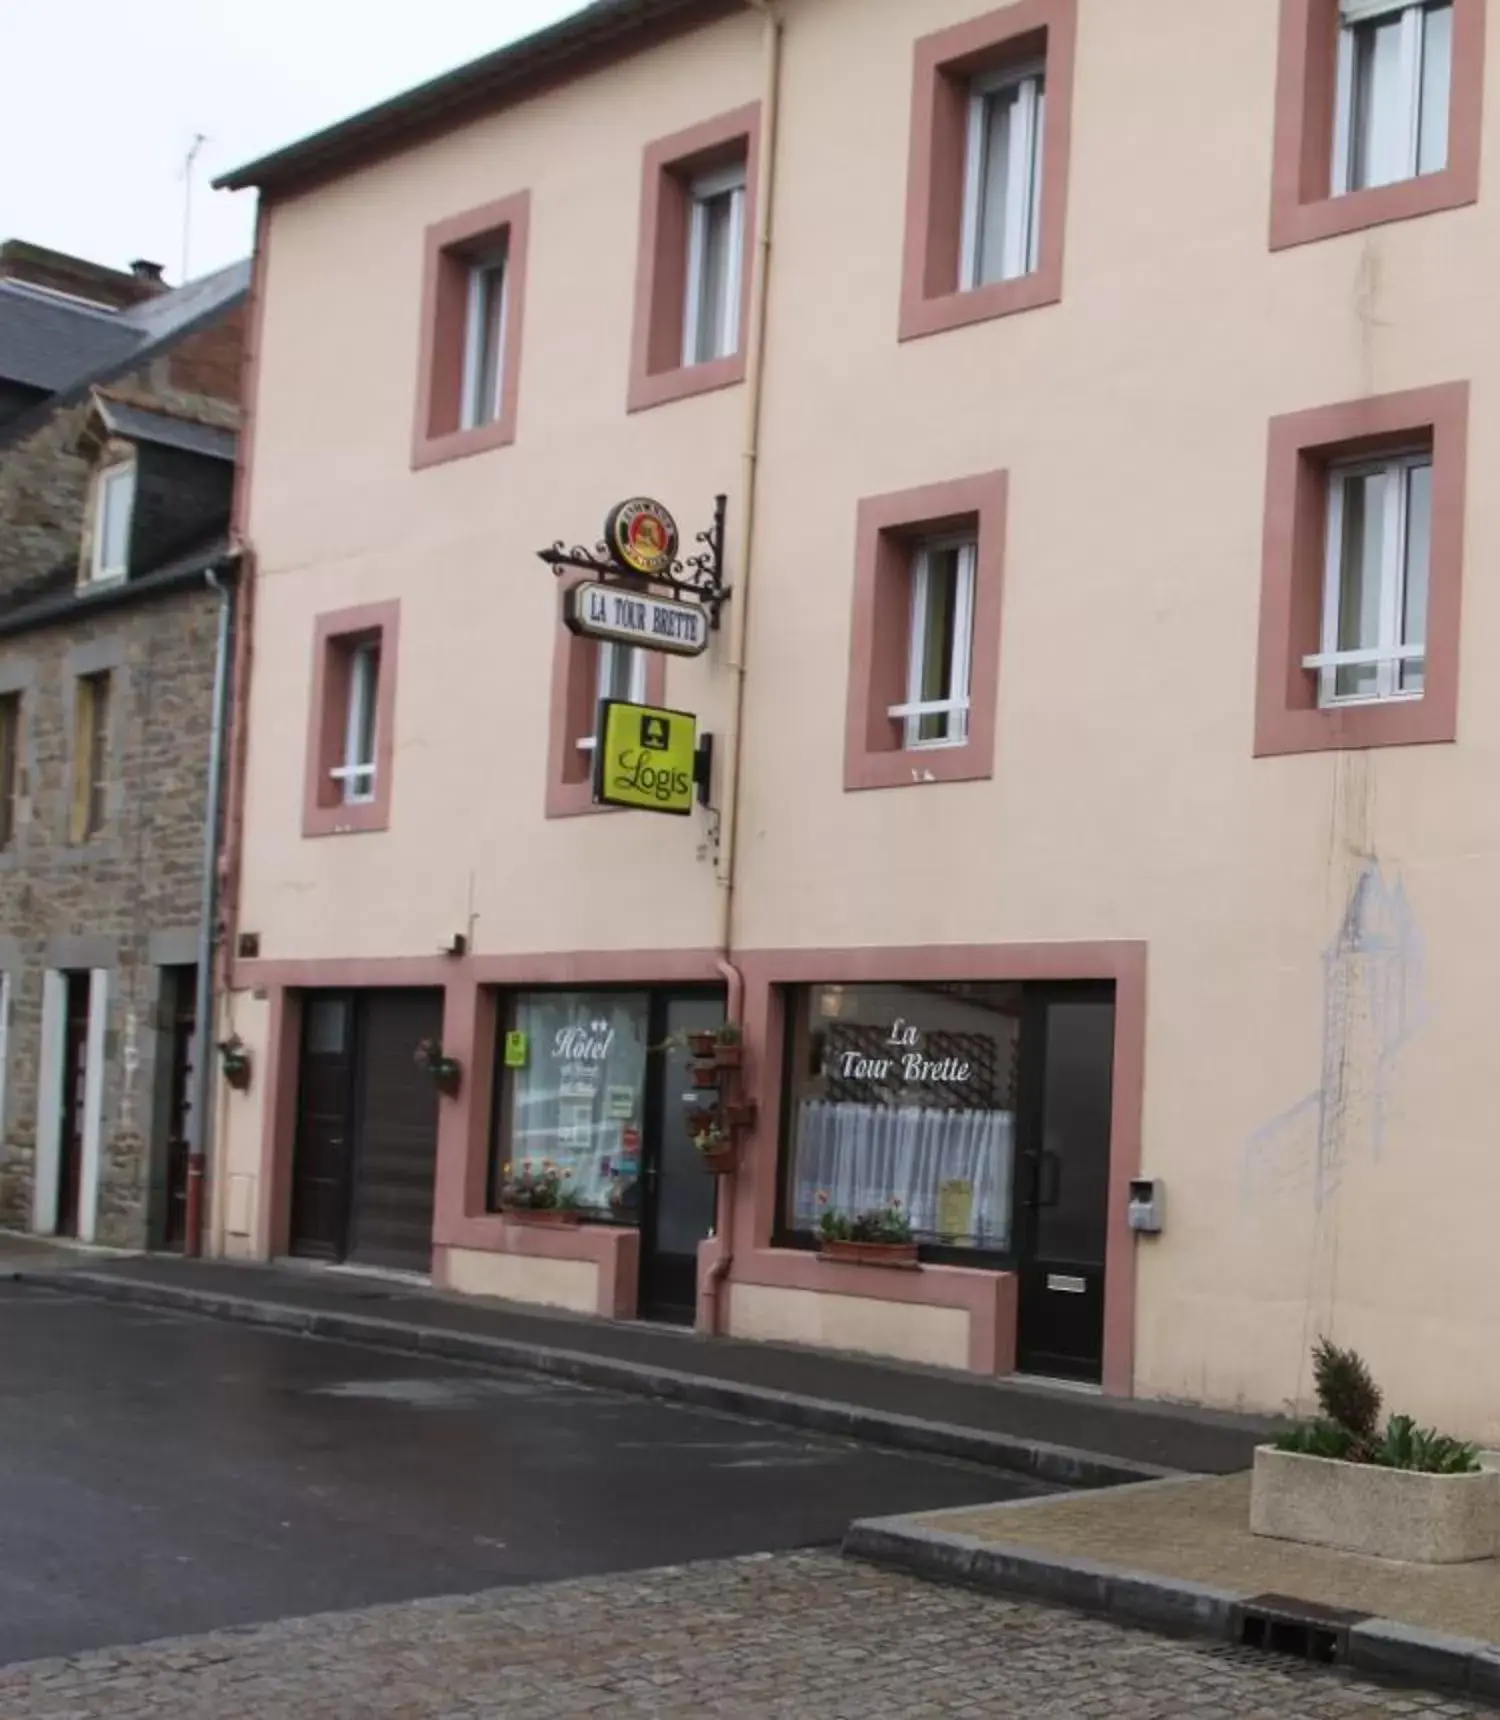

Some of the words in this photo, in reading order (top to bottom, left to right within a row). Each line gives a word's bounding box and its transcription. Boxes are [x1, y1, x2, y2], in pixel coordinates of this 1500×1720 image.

[590, 592, 607, 623] LA
[614, 598, 647, 632] TOUR
[652, 605, 698, 642] BRETTE
[615, 749, 690, 801] Logis
[887, 1018, 920, 1046] La
[840, 1051, 894, 1080] Tour
[901, 1052, 972, 1082] Brette
